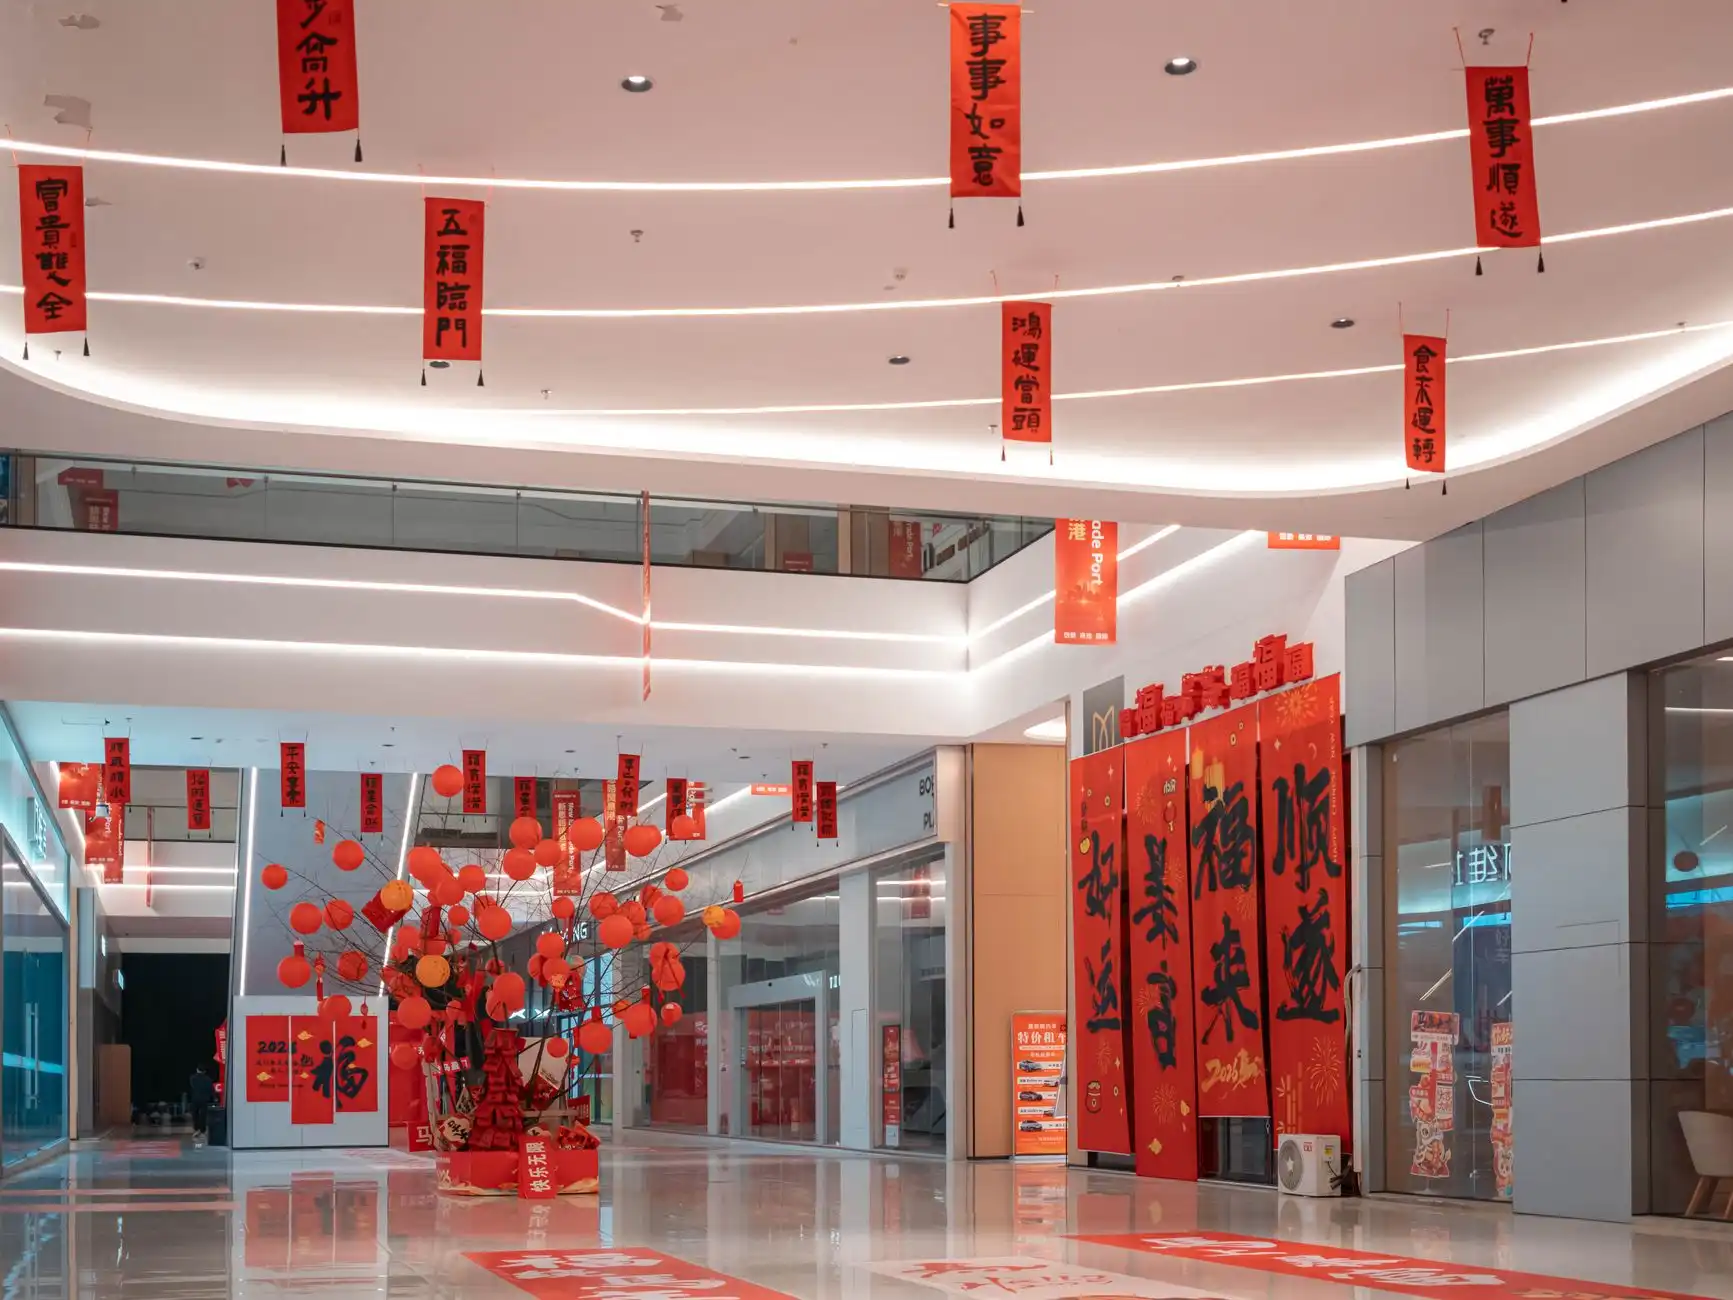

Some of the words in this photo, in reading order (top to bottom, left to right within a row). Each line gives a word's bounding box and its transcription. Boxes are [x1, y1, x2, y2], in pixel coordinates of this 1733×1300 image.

[964, 13, 1007, 187] 事事如意
[435, 208, 469, 349] 五福臨門
[1091, 552, 1104, 586] Port
[1077, 828, 1121, 1034] 好运
[311, 1035, 369, 1109] 福
[526, 1142, 550, 1193] 快乐无限
